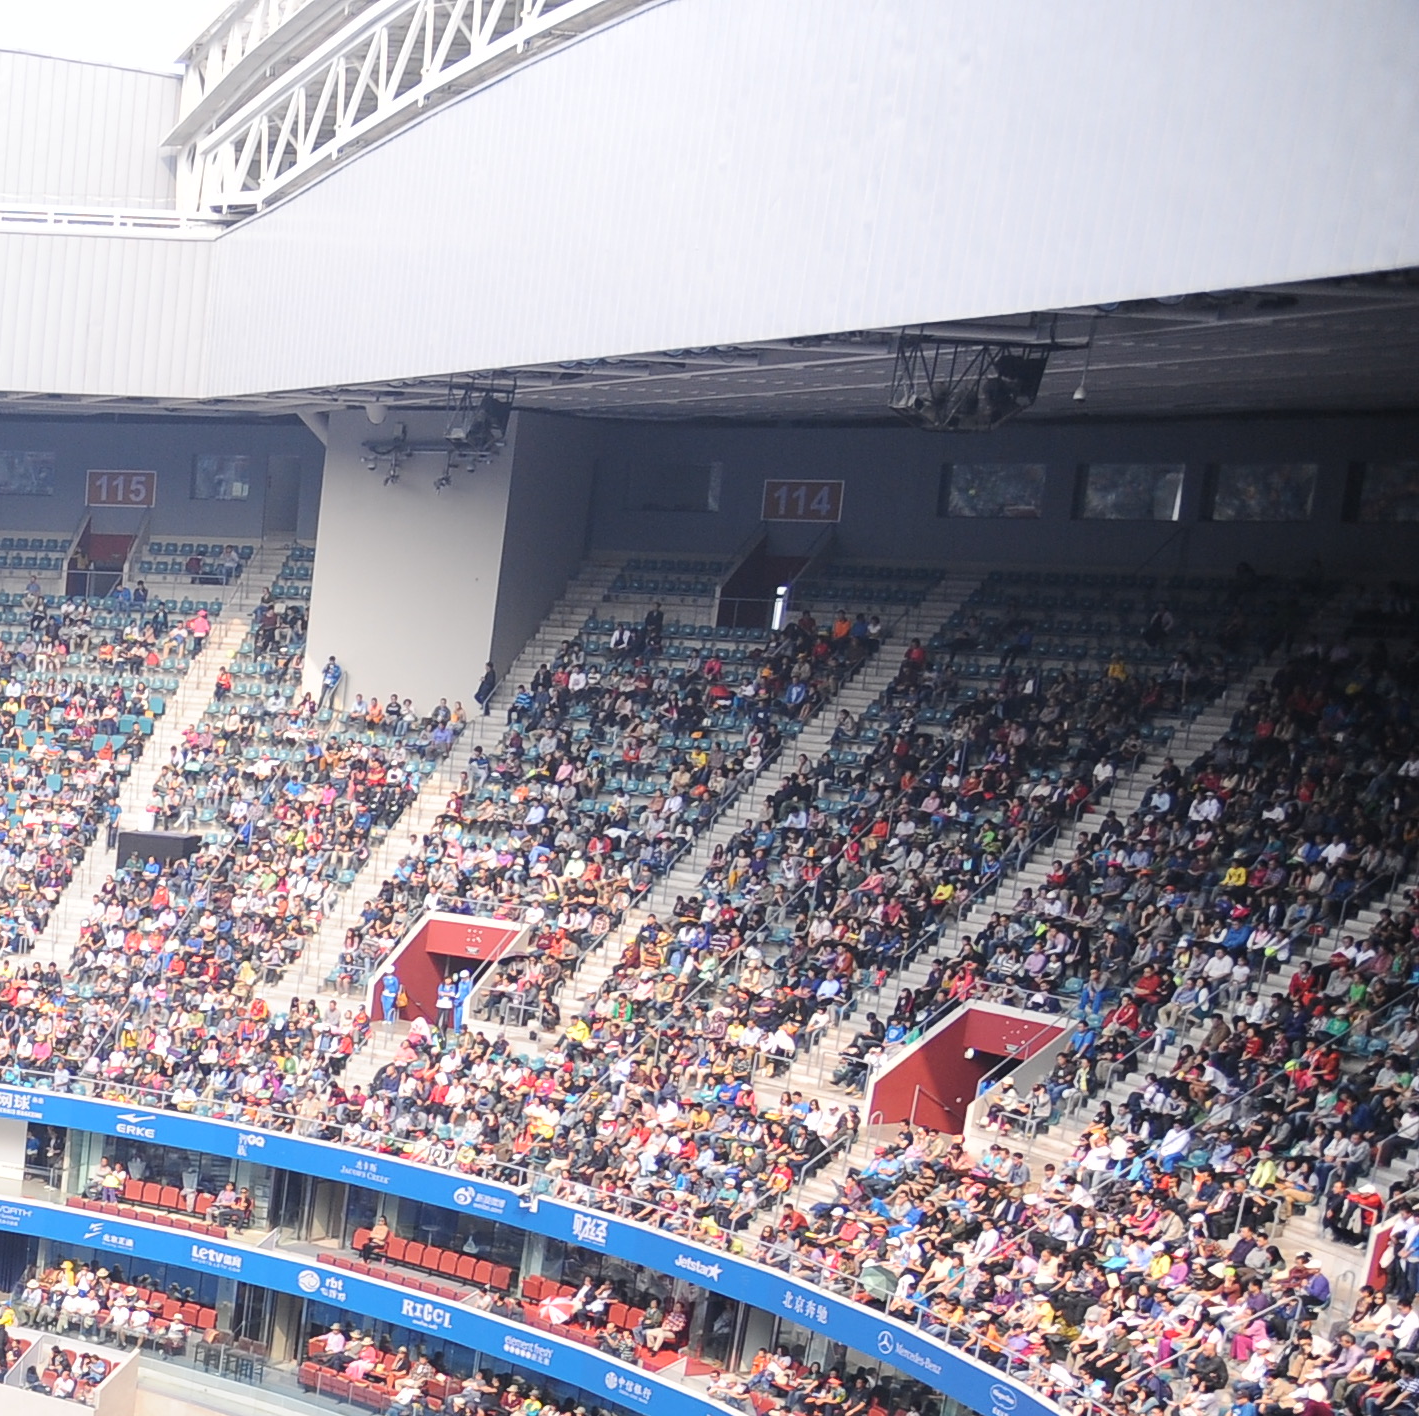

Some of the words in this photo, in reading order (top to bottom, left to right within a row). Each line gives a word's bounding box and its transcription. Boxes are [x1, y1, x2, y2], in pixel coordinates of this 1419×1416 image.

[95, 475, 146, 502] 115
[774, 486, 831, 515] 114
[116, 1123, 156, 1139] ERKE
[248, 1134, 266, 1148] GQ
[573, 1213, 609, 1240] 财经
[674, 1254, 711, 1276] Jetstar
[325, 1277, 345, 1290] rbt
[782, 1291, 828, 1325] 北京奔驰
